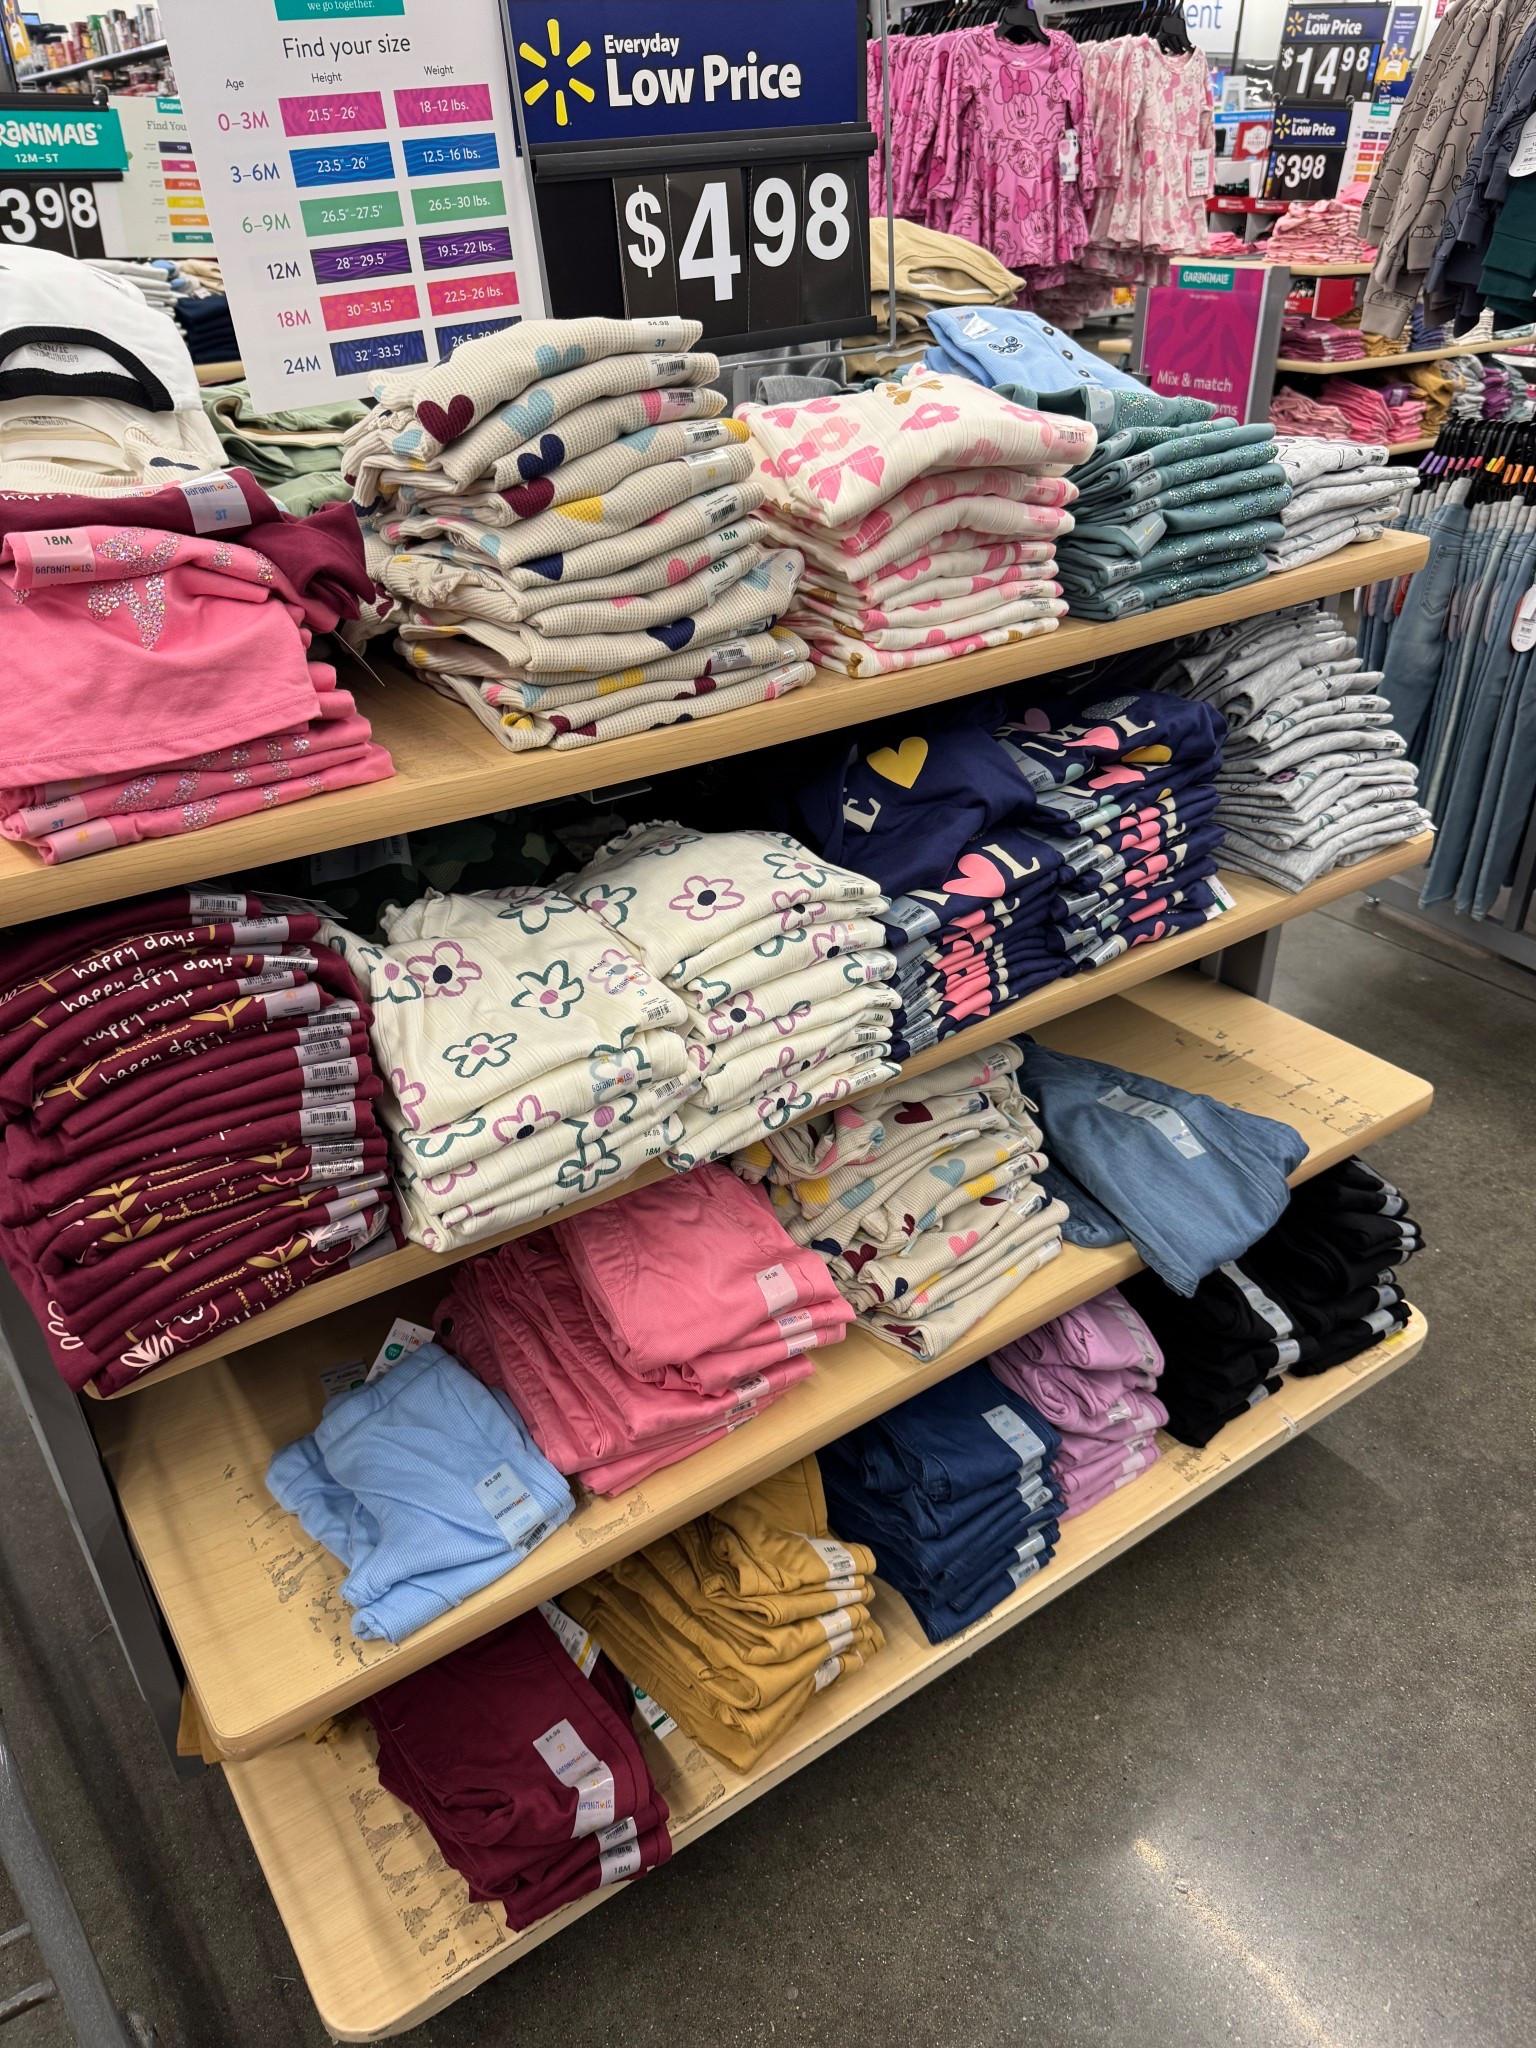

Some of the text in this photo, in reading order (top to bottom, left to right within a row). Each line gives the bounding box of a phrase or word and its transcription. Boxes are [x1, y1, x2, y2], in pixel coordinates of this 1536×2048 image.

[1304, 19, 1362, 35] Low Price
[283, 34, 411, 62] Find your size
[604, 34, 680, 57] Everyday
[311, 72, 343, 84] Height
[424, 65, 454, 77] Weight
[225, 79, 245, 91] Age
[605, 51, 802, 108] Low Price
[420, 98, 469, 114] 18-12 lbs.
[146, 121, 166, 131] Find
[218, 110, 270, 132] 0-3M
[1291, 123, 1336, 136] Low Price
[15, 153, 59, 164] 12M-5T
[423, 147, 481, 164] 12.5-16 lbs.
[230, 163, 281, 184] 3-6M
[429, 195, 491, 212] 26.5-30 lbs.
[242, 213, 291, 234] 6-9M
[437, 241, 496, 258] 19.5-22 lbs.
[267, 261, 302, 280] 12M
[444, 286, 504, 304] 22.5-26 lbs.
[277, 309, 312, 329] 18M
[655, 339, 666, 348] 3T
[284, 355, 321, 375] 24M
[1157, 371, 1233, 393] Mix & match
[215, 509, 228, 521] 3T
[43, 535, 73, 547] 18M
[718, 530, 739, 542] 18M
[708, 561, 729, 575] 18M
[785, 561, 795, 572] 3T
[52, 818, 65, 830] 3T
[72, 931, 196, 979] happy days
[605, 968, 616, 977] 3T
[61, 980, 126, 1014] happy
[637, 988, 648, 997] 3T
[99, 1054, 162, 1084] happy
[764, 1271, 779, 1281] $4.98
[484, 1471, 502, 1488] $3.98
[545, 1728, 561, 1743] $4.98
[557, 1743, 566, 1752] 2T
[613, 1864, 631, 1875] 18M
